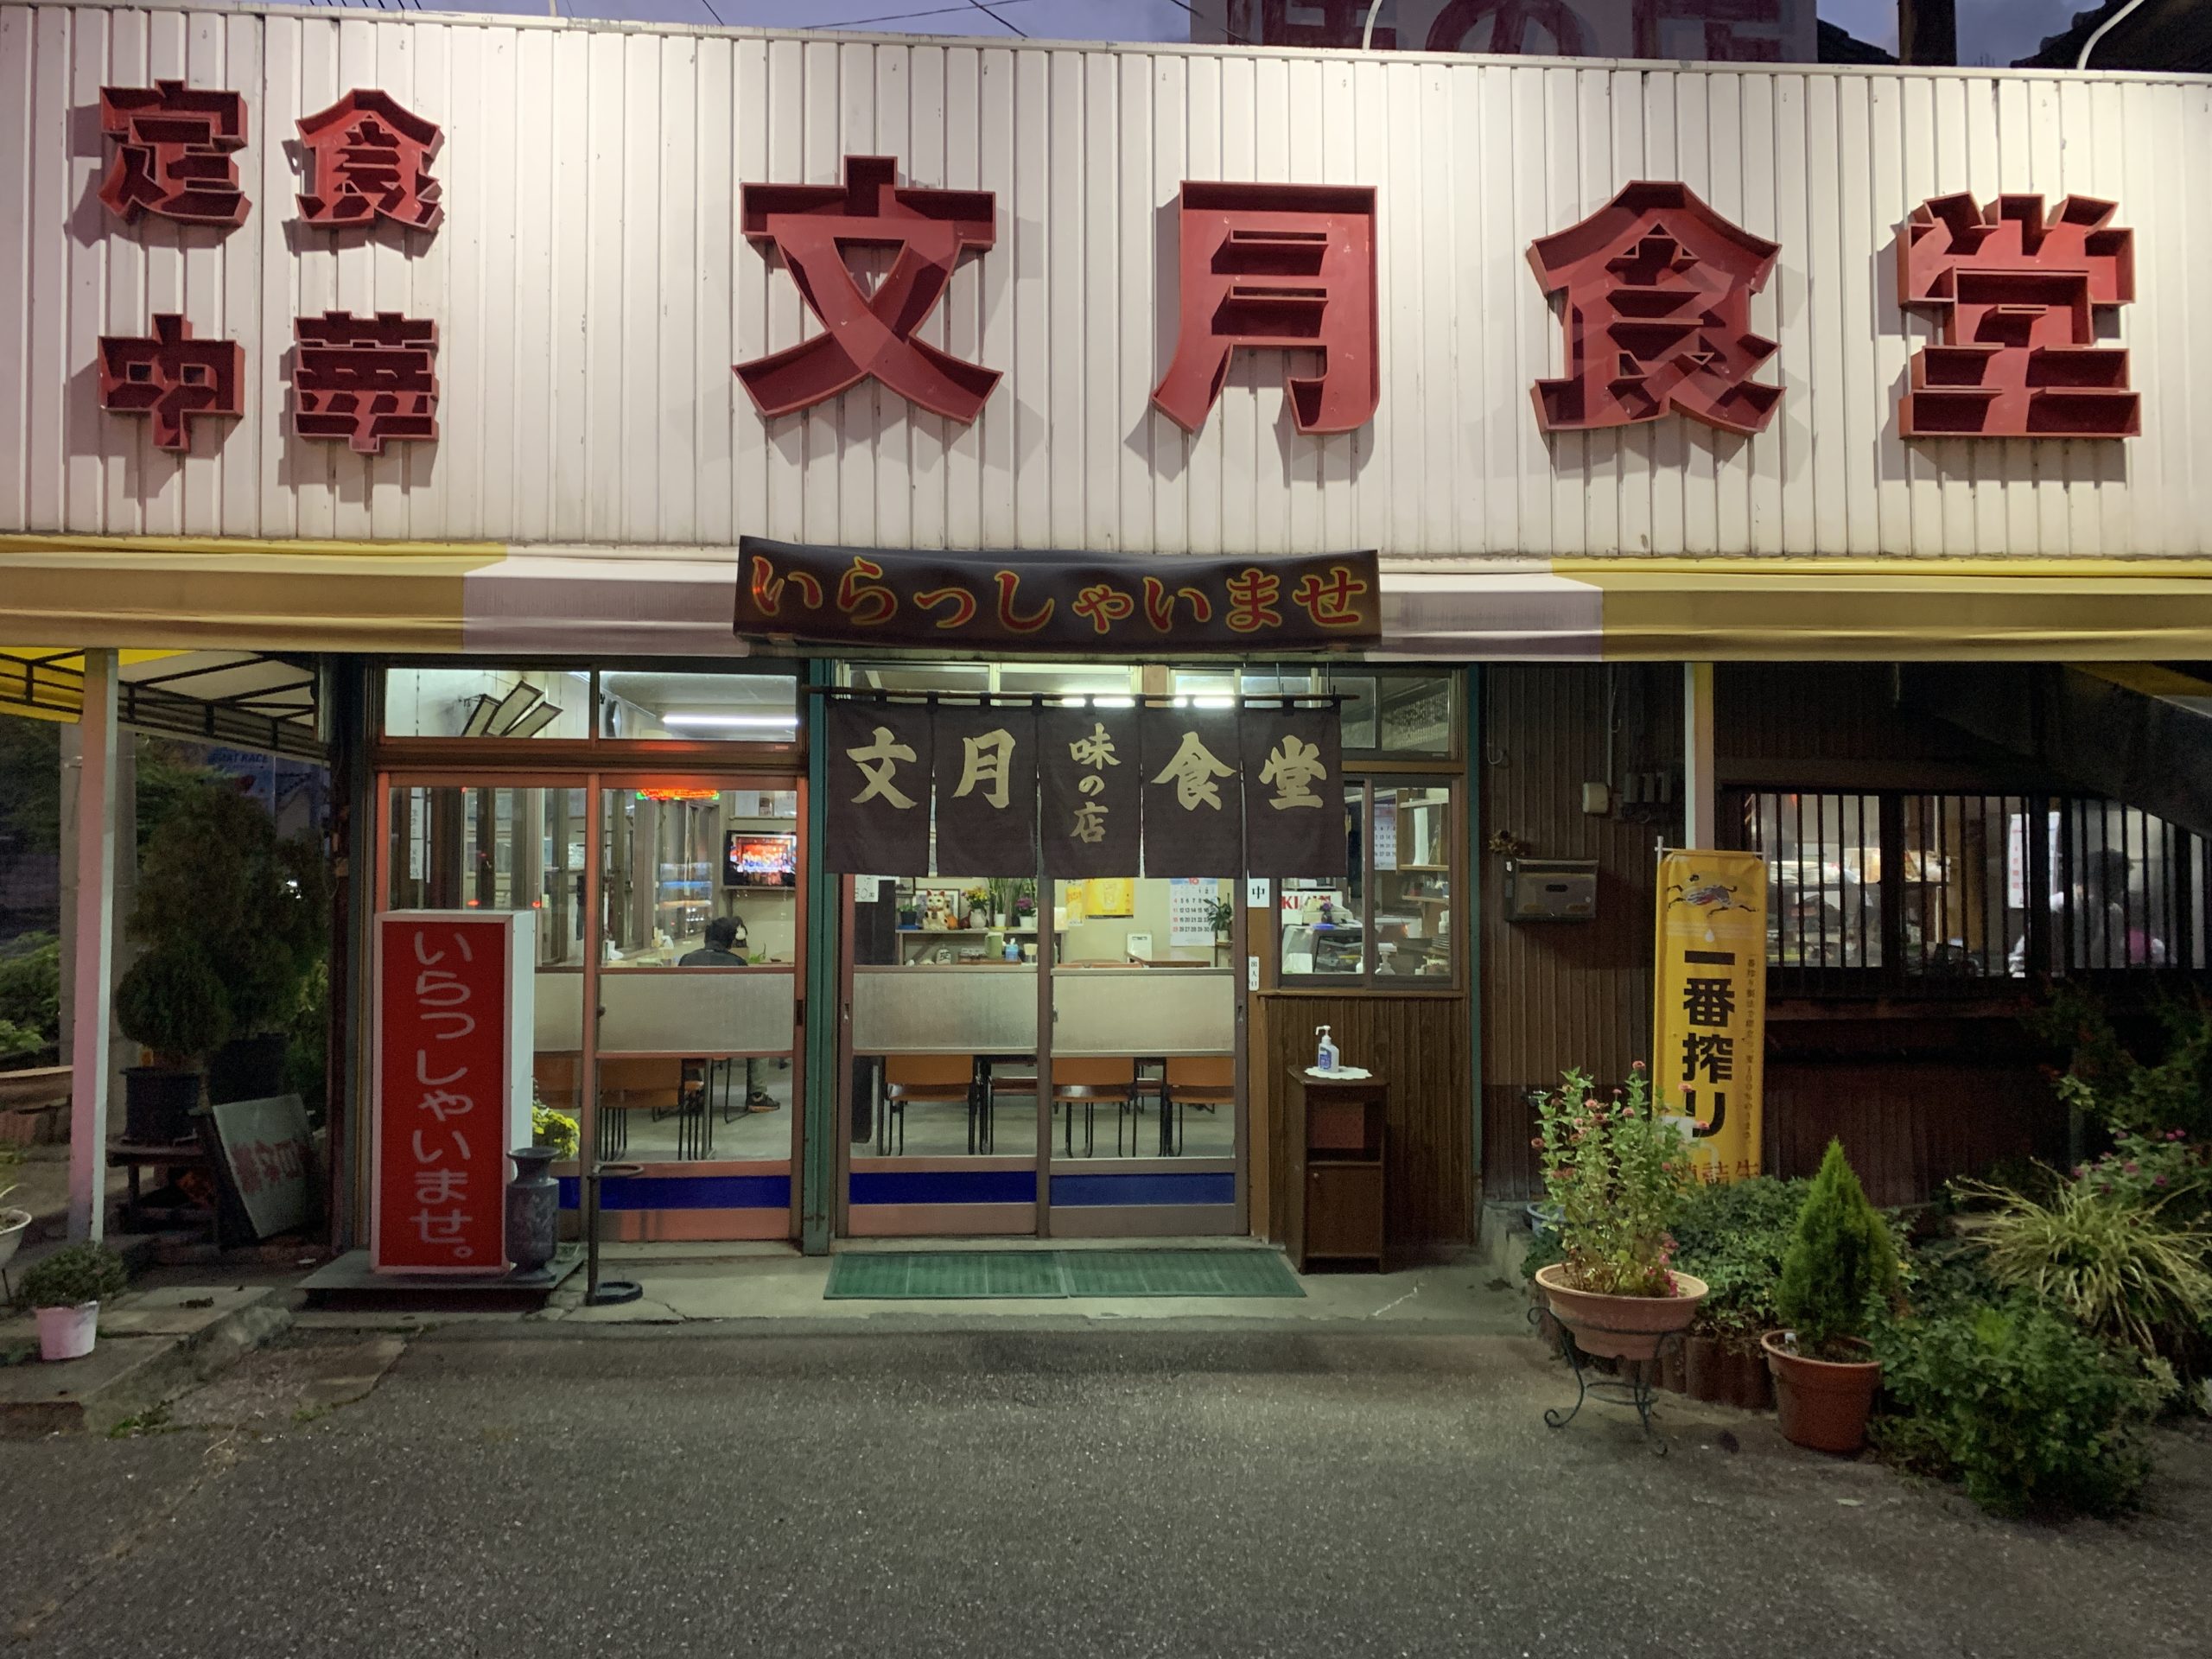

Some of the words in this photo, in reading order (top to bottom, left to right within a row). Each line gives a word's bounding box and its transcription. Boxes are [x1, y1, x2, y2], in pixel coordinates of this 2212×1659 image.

[99, 79, 445, 233] 定食
[731, 156, 2142, 437] 文月食堂
[99, 312, 439, 454] 中華
[752, 556, 1367, 634] いらっしゃいませ
[1069, 721, 1121, 843] 味の店
[1252, 886, 1265, 899] 中
[1681, 950, 1736, 1139] 一番搾り
